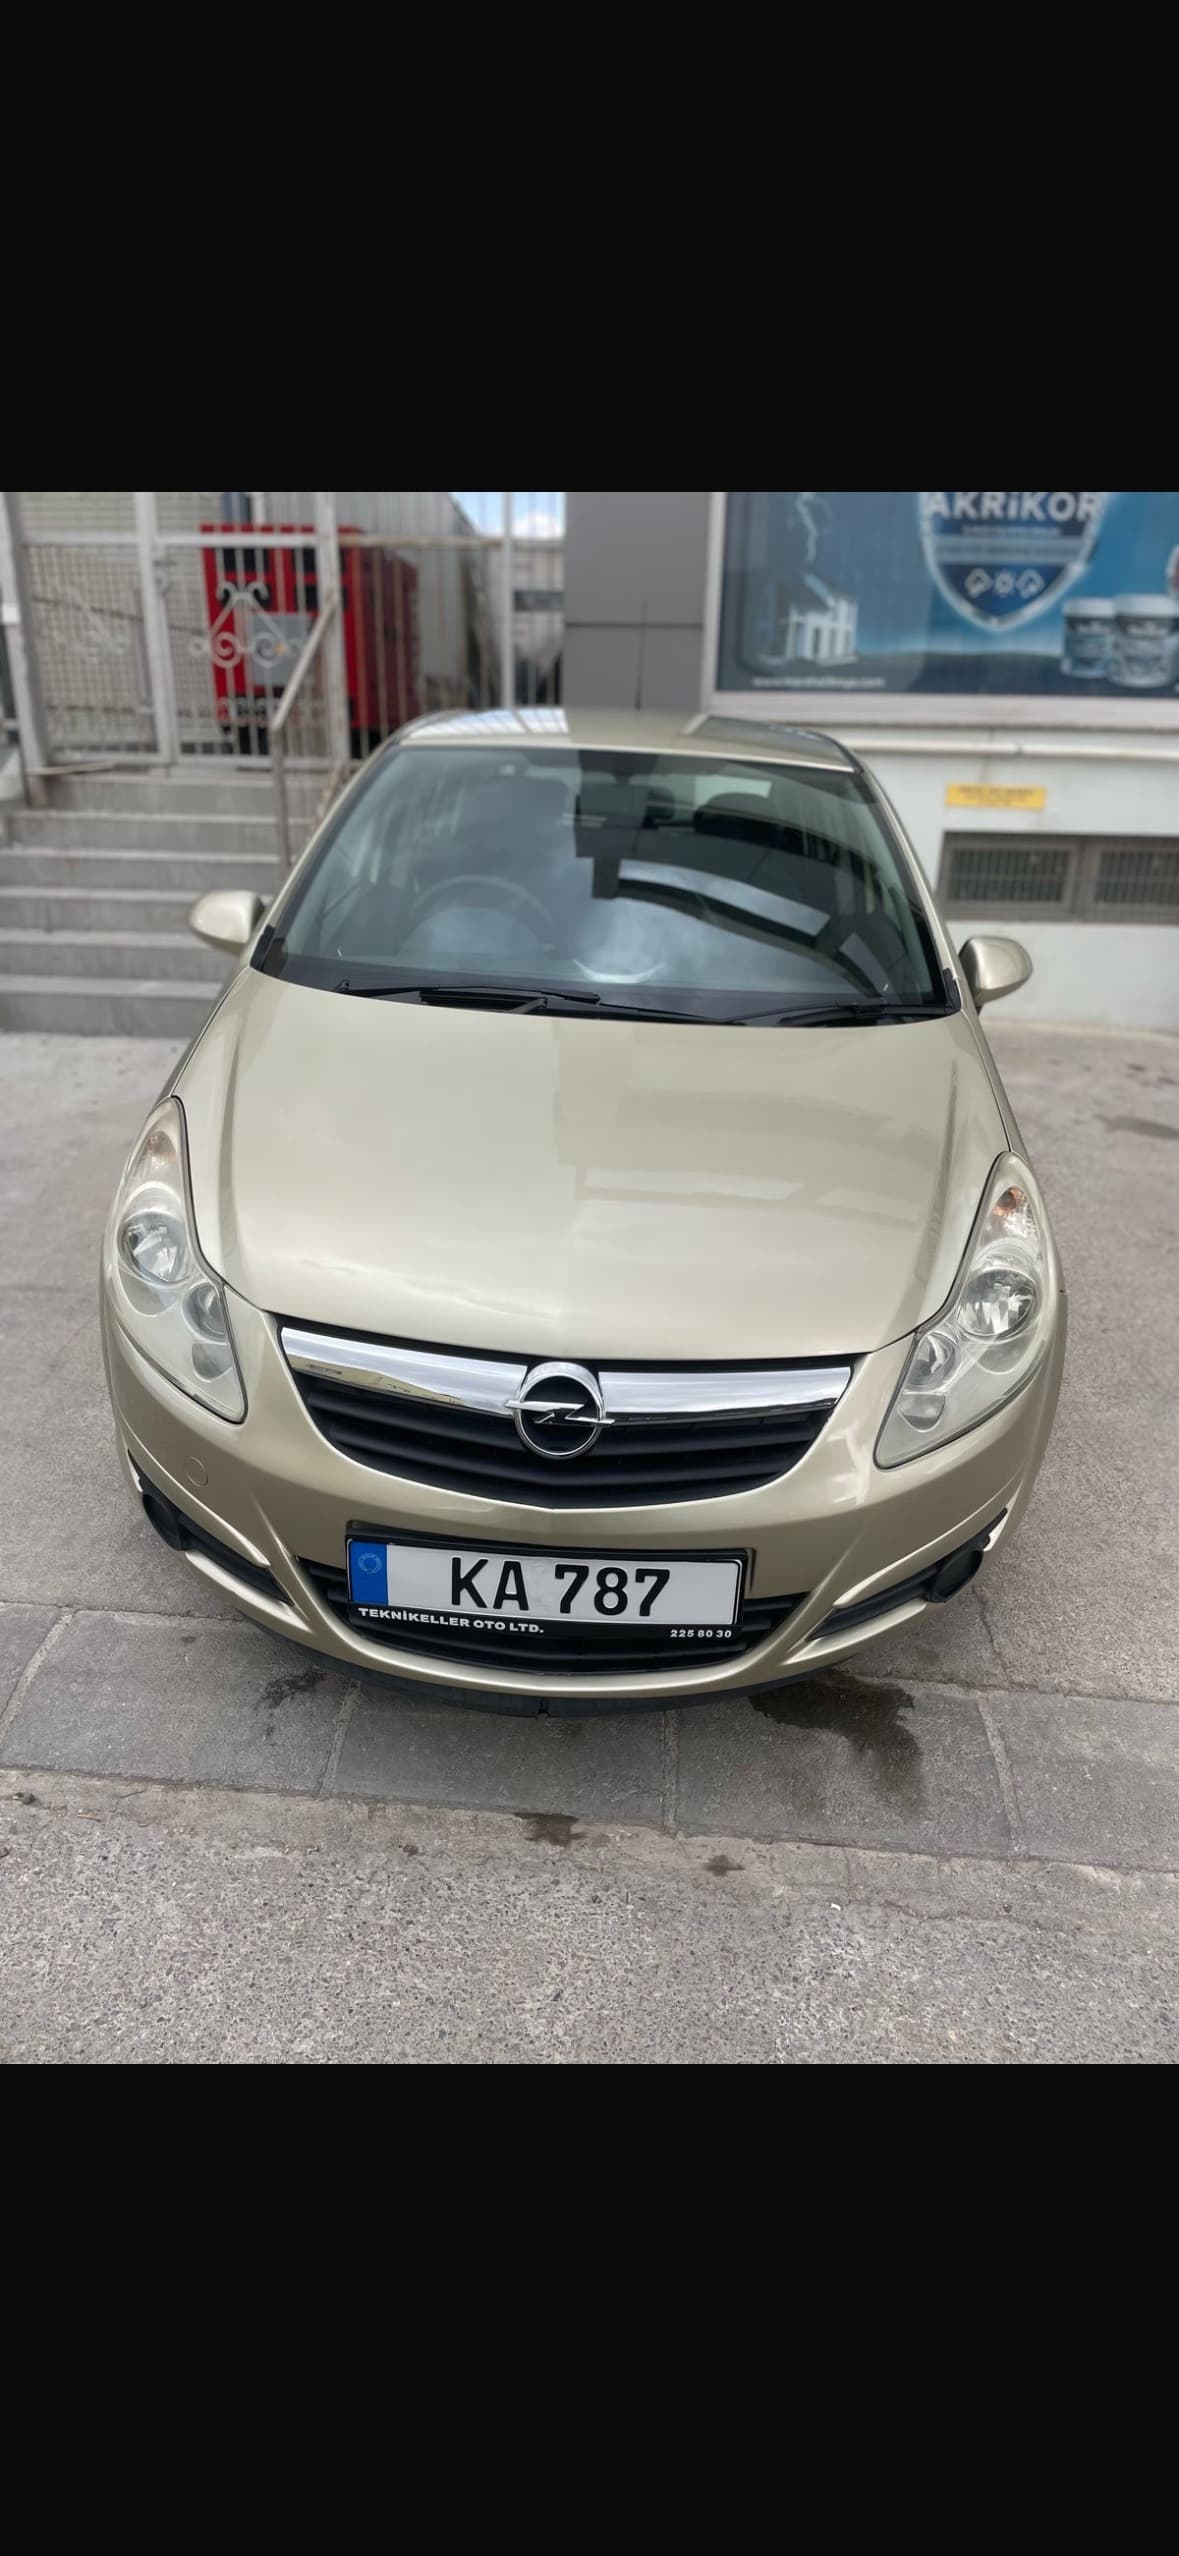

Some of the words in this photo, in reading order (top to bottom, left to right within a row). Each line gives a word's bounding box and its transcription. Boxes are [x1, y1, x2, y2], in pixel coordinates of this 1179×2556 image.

[452, 1557, 529, 1611] KA
[555, 1564, 670, 1617] 787
[358, 1608, 470, 1628] TEKNİKELLER
[473, 1619, 506, 1631] OTO
[509, 1623, 545, 1633] LTD.
[670, 1629, 695, 1638] 225
[697, 1629, 713, 1638] 80
[717, 1629, 732, 1638] 30
